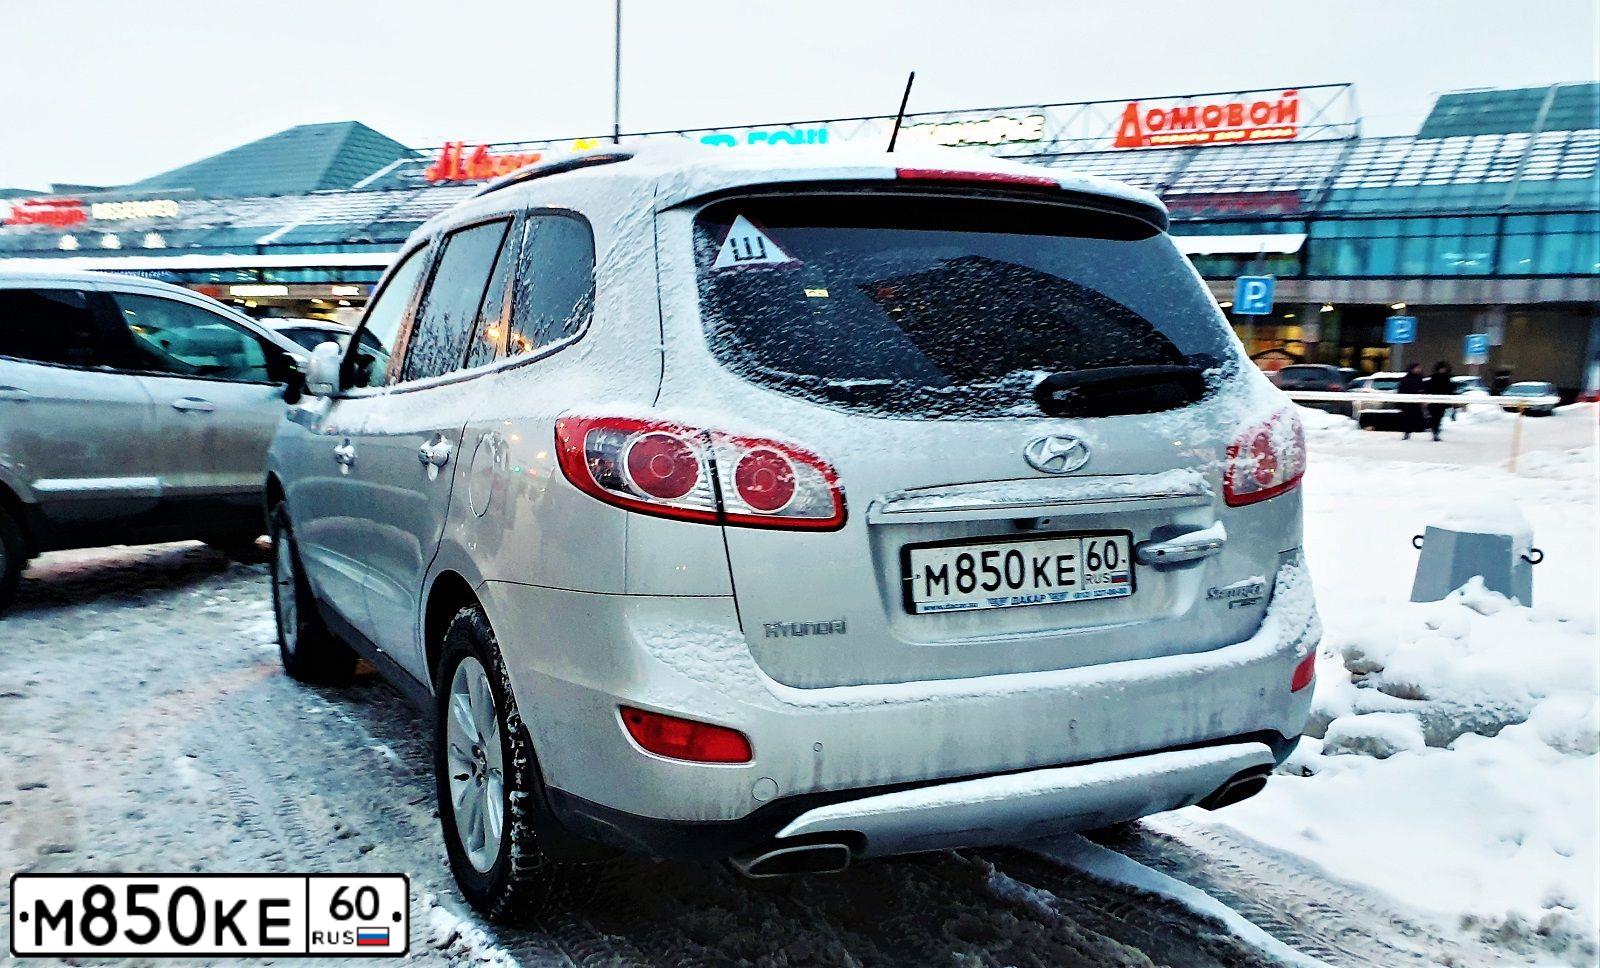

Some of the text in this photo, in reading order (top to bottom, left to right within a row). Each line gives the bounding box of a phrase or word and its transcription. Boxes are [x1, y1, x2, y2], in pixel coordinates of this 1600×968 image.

[1114, 90, 1297, 147] ДОМОВОЙ
[730, 236, 767, 261] Ш
[1243, 281, 1267, 309] P
[925, 540, 1119, 596] М850КЕ 60
[1085, 573, 1111, 585] RUS
[763, 619, 847, 638] HYUNDAI
